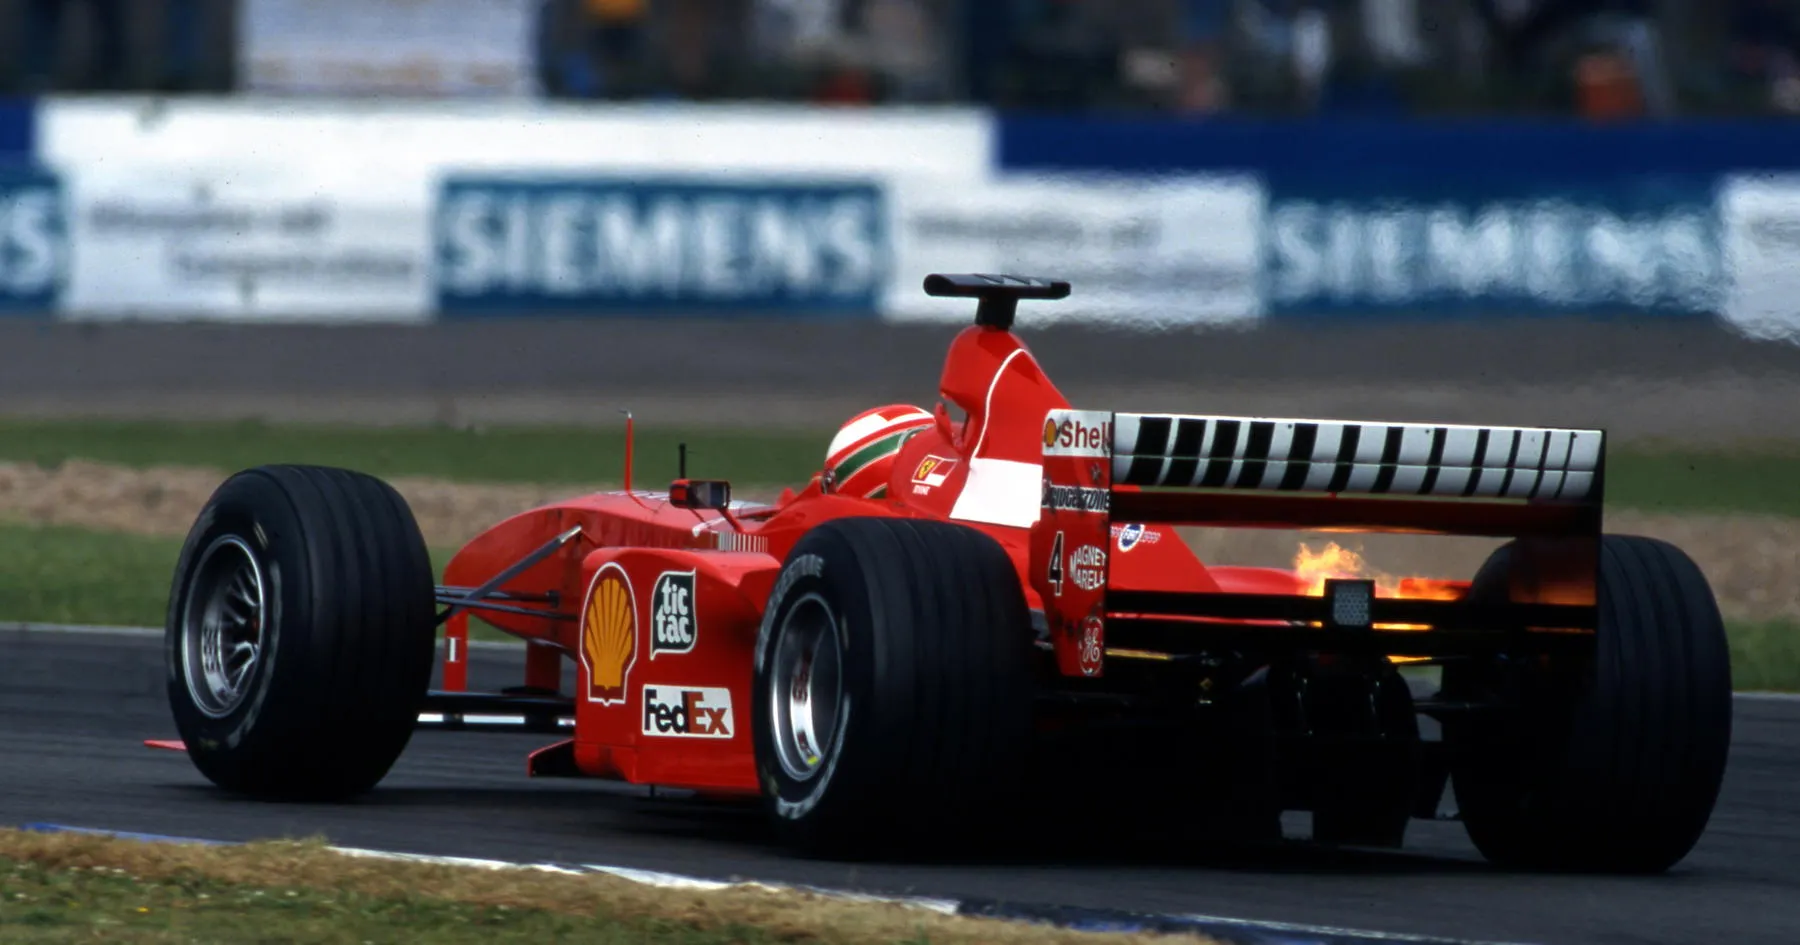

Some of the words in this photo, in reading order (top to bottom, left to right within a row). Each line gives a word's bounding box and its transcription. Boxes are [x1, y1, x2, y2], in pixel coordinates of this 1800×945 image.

[445, 191, 875, 294] SIEMENS
[1061, 419, 1112, 449] Shell
[1048, 530, 1064, 597] 4
[662, 576, 688, 615] tic
[656, 604, 691, 643] tac
[644, 688, 730, 734] FedEx
